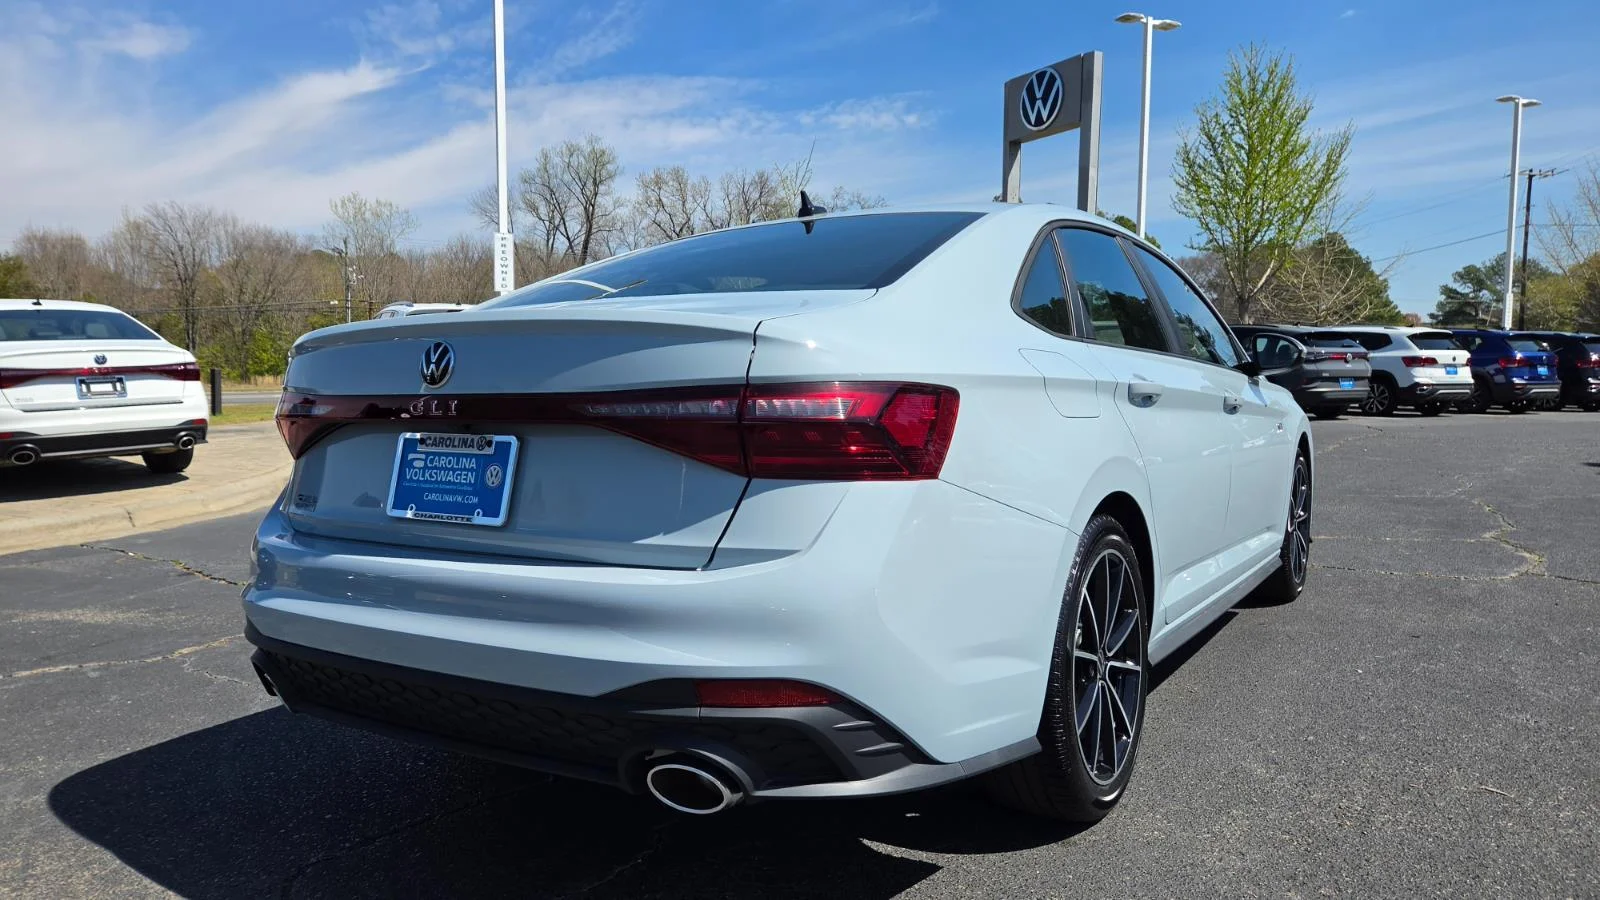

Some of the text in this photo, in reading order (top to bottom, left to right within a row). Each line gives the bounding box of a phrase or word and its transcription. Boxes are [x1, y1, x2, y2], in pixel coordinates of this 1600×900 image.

[1021, 68, 1062, 130] VW
[422, 341, 454, 388] VW
[410, 400, 457, 415] GLI
[425, 436, 475, 450] CAROLINA
[426, 455, 477, 469] CAROLINA
[405, 467, 476, 484] VOLKSWAGEN
[423, 492, 479, 504] CAROLINAVW.COM
[413, 512, 473, 523] CHARLOTTE
